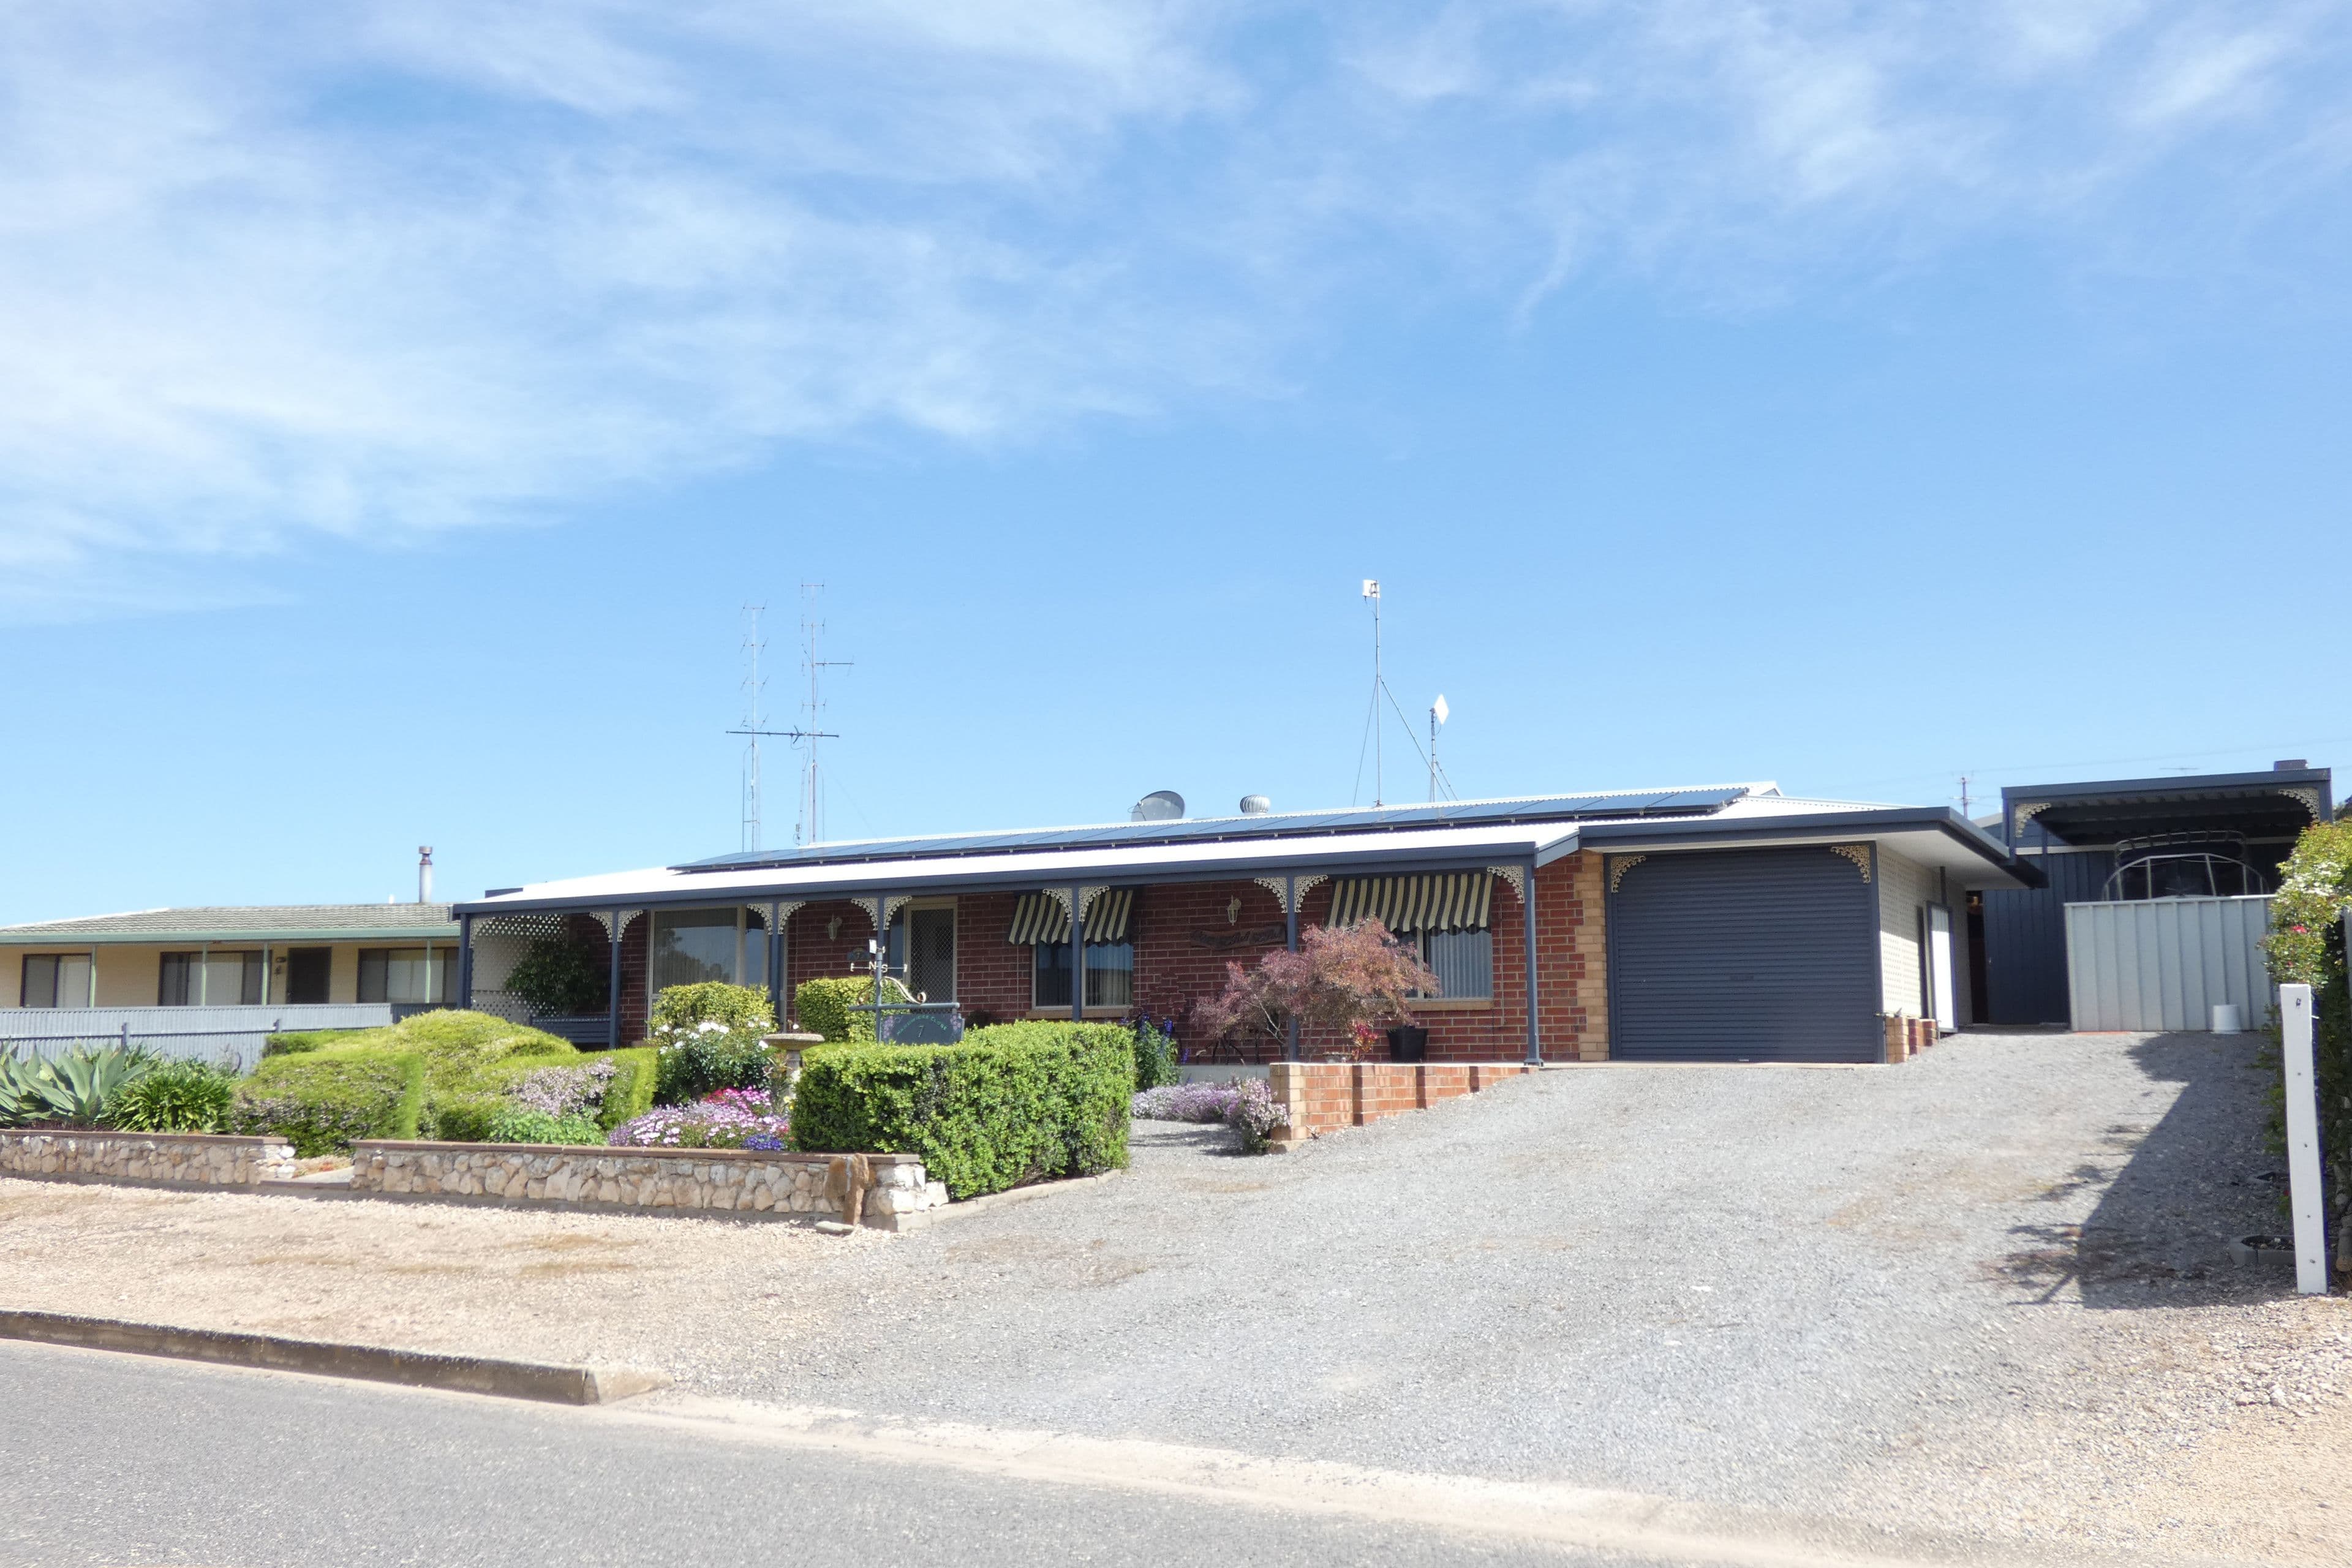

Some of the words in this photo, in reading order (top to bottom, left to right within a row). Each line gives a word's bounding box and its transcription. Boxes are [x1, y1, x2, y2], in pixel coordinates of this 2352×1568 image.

[869, 961, 876, 970] N
[881, 964, 888, 973] S
[918, 1025, 924, 1038] 7
